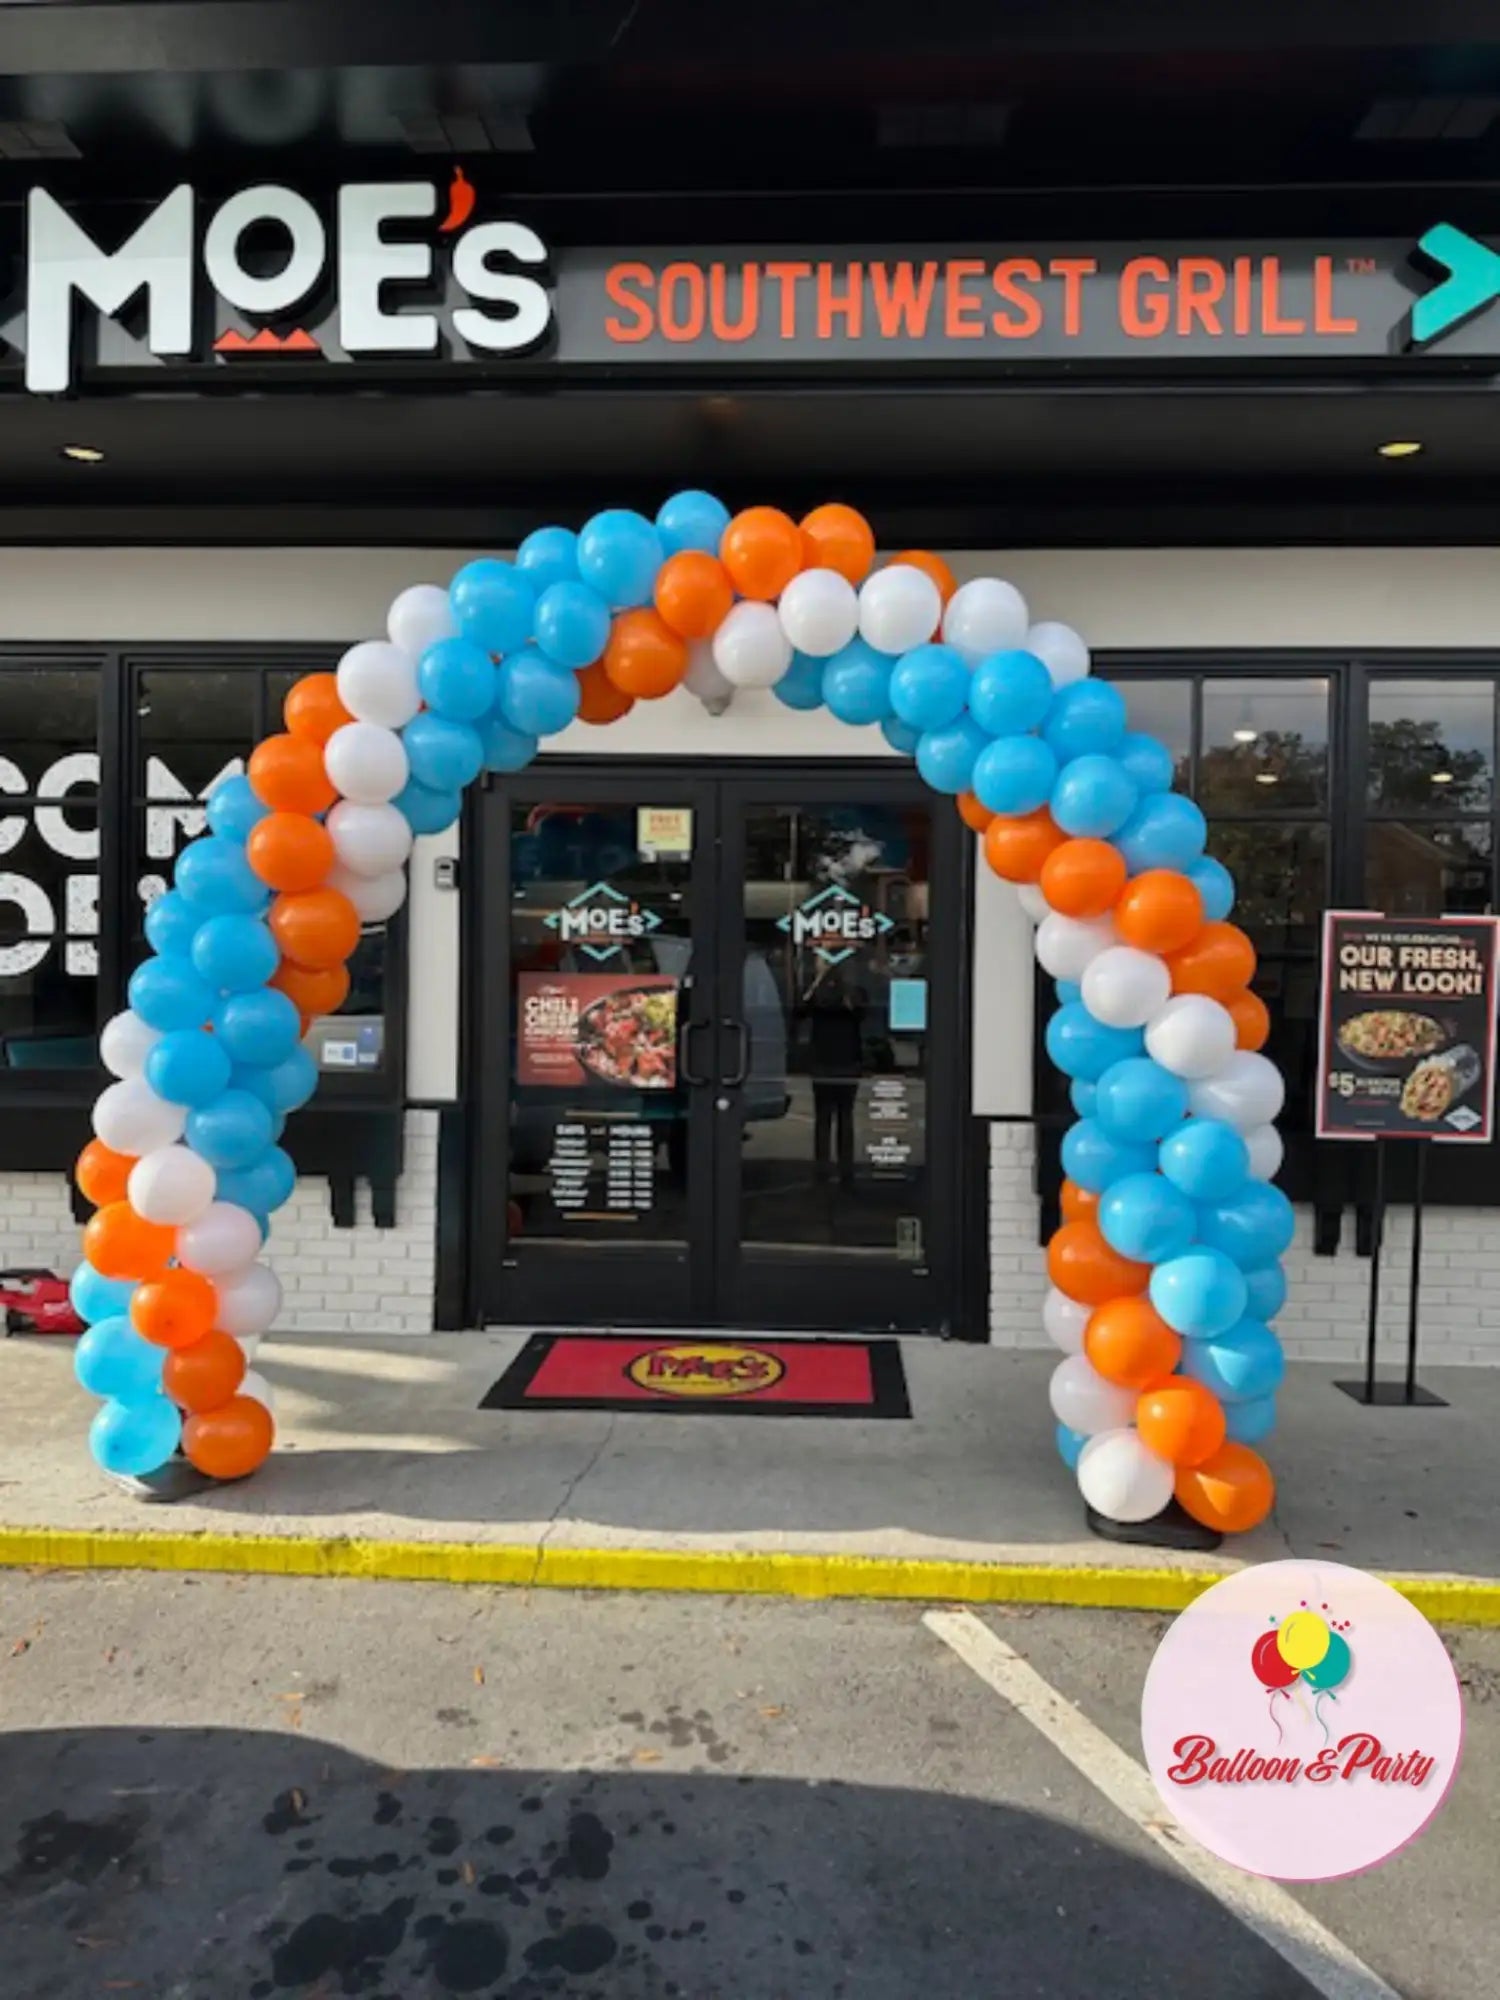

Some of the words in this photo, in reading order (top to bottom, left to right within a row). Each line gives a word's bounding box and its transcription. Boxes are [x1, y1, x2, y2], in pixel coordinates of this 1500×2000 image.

[604, 258, 1097, 343] SOUTHWEST
[1118, 256, 1358, 338] GRILL
[1340, 944, 1393, 967] OUR
[1399, 946, 1482, 972] FRESH,
[1340, 967, 1397, 991] NEW
[1402, 971, 1482, 995] LOOK!
